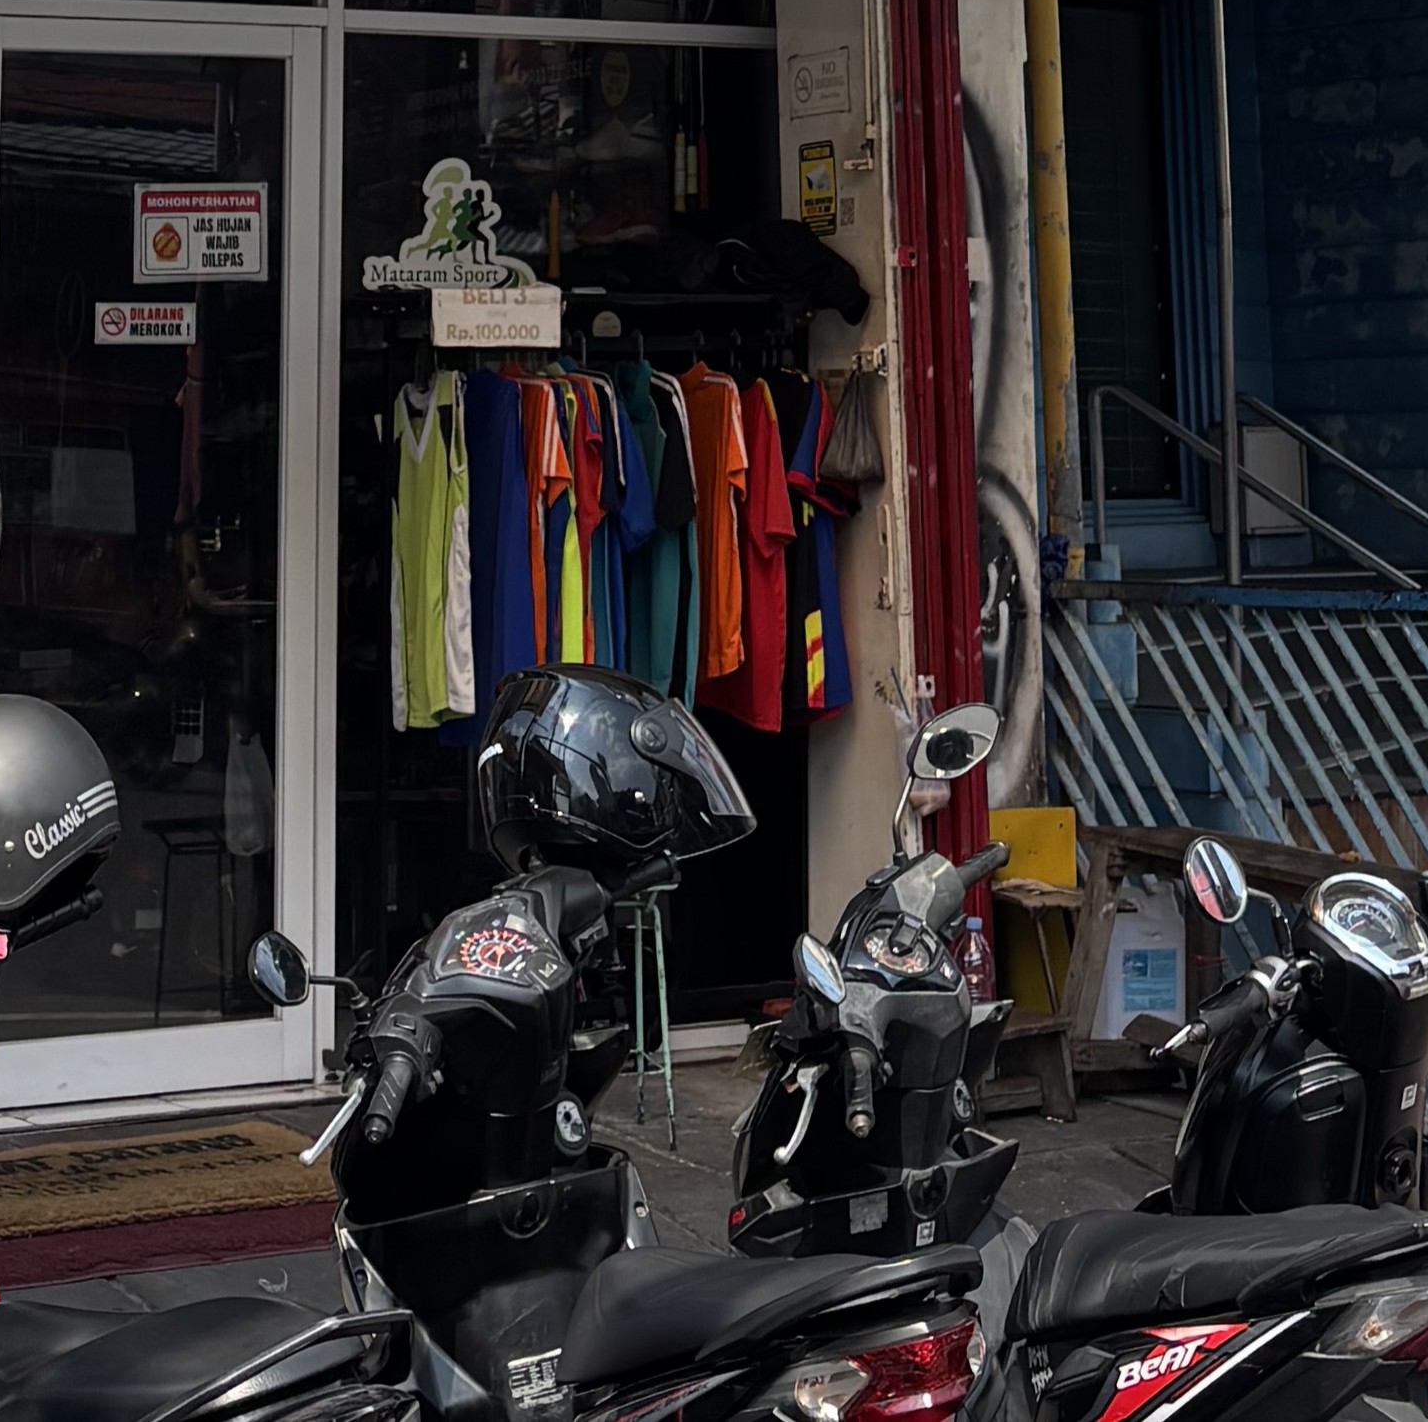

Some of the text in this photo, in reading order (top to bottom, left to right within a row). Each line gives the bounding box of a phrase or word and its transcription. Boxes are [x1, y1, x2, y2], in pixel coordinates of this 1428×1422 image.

[147, 196, 255, 208] MOHON PERHATIAN
[193, 217, 251, 233] JAS HUJAN
[206, 236, 239, 250] WAJIB
[202, 253, 243, 268] DILEPAS
[371, 264, 499, 287] Mataram Sport
[130, 308, 184, 321] DILARANG
[129, 323, 182, 337] MEROKOK
[446, 324, 540, 341] Rp.100.000
[24, 801, 88, 860] Classic
